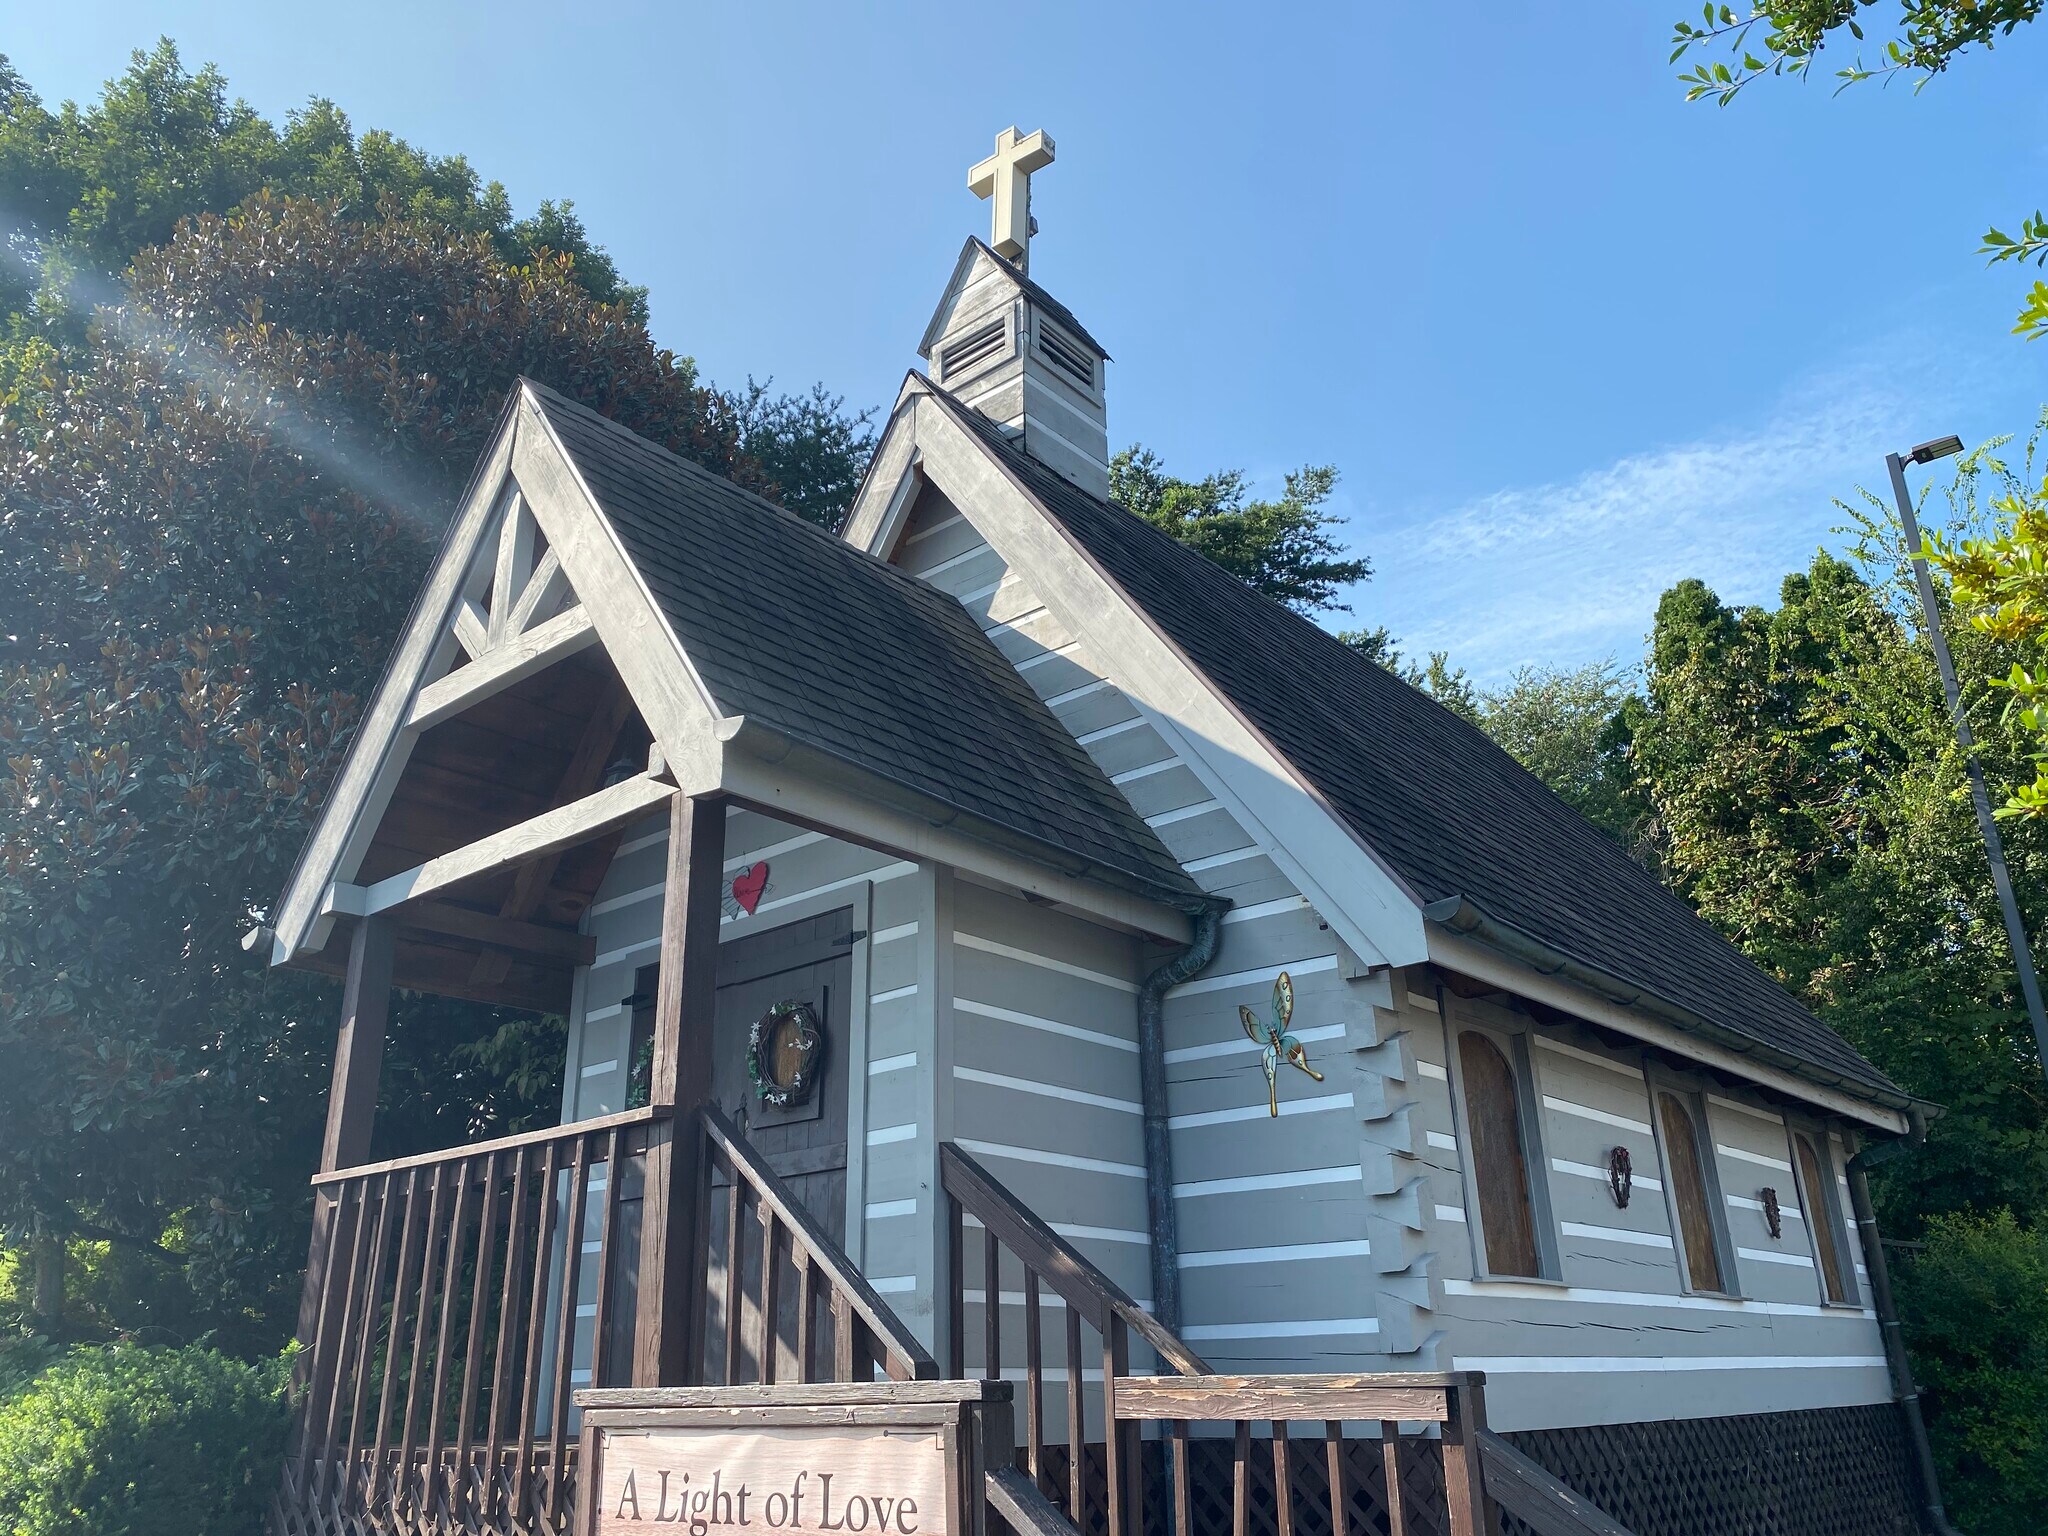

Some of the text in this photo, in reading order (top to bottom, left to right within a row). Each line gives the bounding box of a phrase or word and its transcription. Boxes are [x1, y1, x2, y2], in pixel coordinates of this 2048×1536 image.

[615, 1468, 918, 1536] A Light of Love
